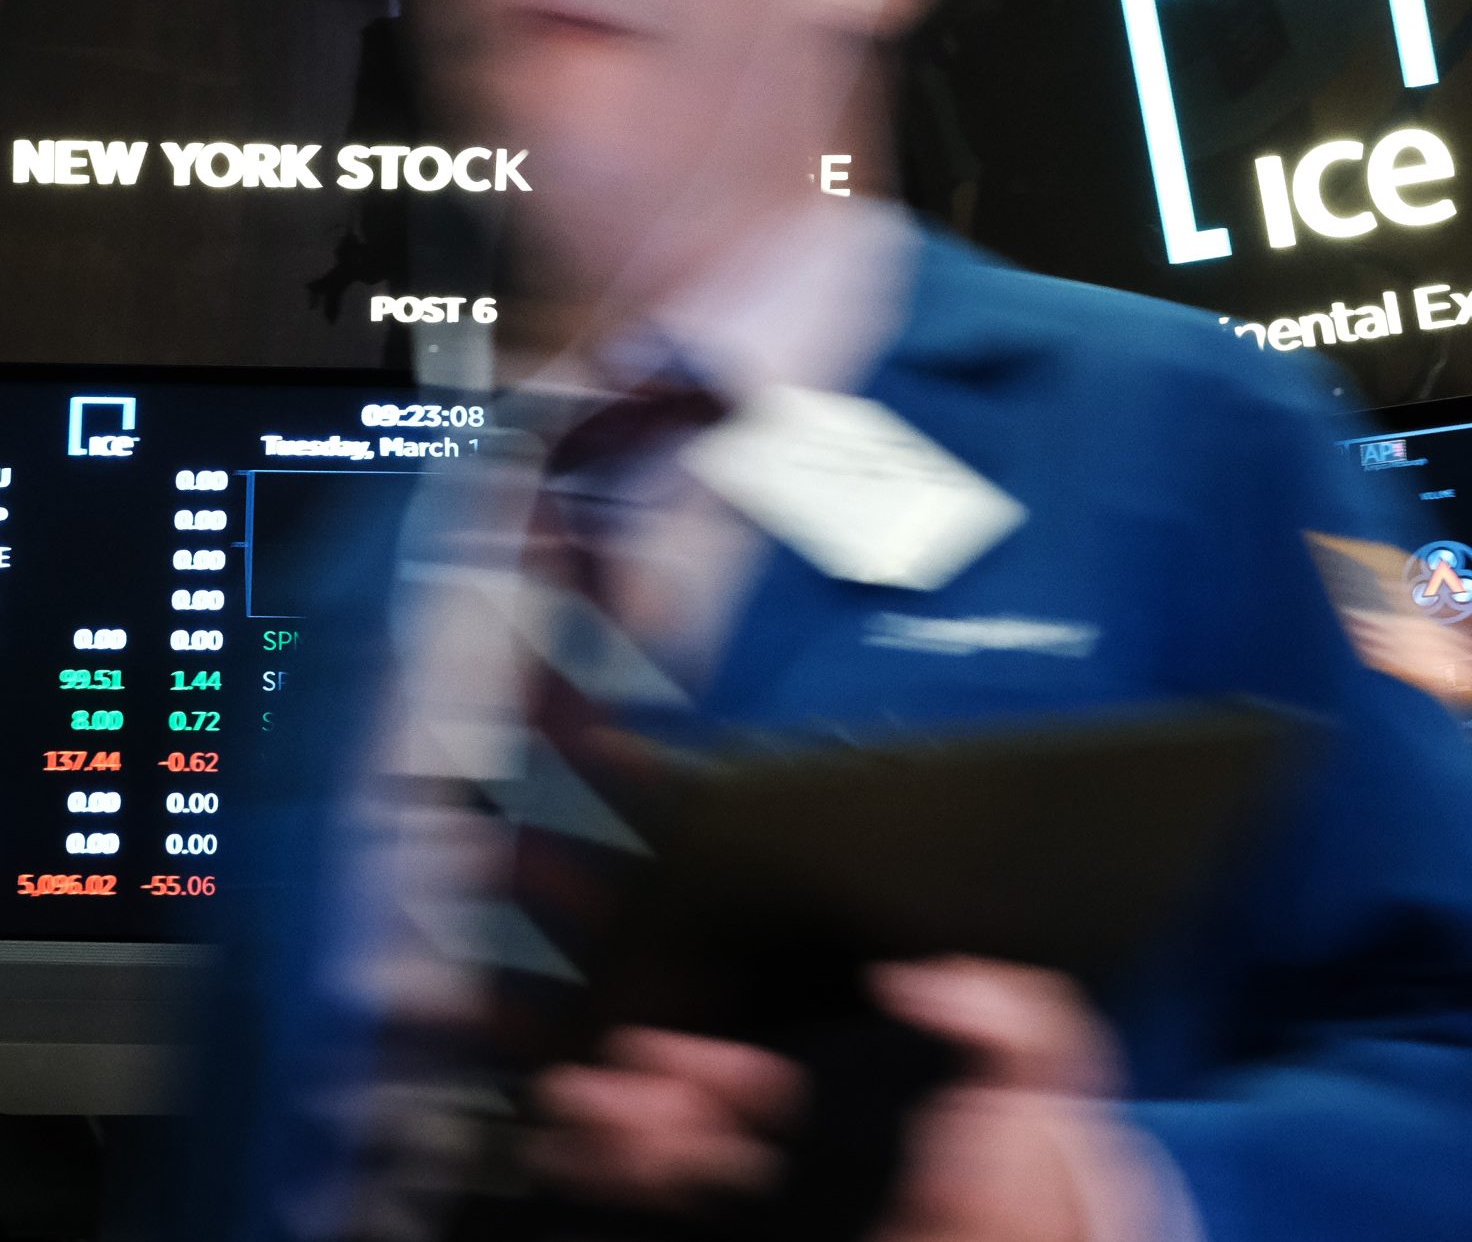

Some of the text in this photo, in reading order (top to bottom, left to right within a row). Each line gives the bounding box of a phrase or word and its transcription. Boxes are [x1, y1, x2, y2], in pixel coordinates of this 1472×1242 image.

[11, 139, 148, 187] NEW
[161, 142, 324, 190] YORK
[336, 144, 532, 193] STOCK
[370, 296, 498, 326] POST 6
[260, 434, 375, 461] Tuesday,
[378, 436, 459, 459] March
[175, 469, 228, 491] 0.00
[173, 509, 227, 531] 0.00
[172, 549, 226, 571] 0.00
[171, 589, 225, 612] 0.00
[73, 628, 127, 651] 0.00
[169, 629, 224, 651] 0.00
[58, 668, 125, 691] 99.51
[169, 670, 223, 692] 1.44
[70, 709, 124, 732] 8.00
[168, 710, 221, 733] 0.72
[42, 750, 122, 772] 137.44
[157, 751, 219, 773] -0.62
[66, 791, 122, 814] 0.00
[165, 792, 219, 815] 0.00
[65, 832, 121, 855] 0.00
[164, 833, 218, 856] 0.00
[16, 873, 118, 897] 5,096.02
[140, 874, 216, 897] -55.06
